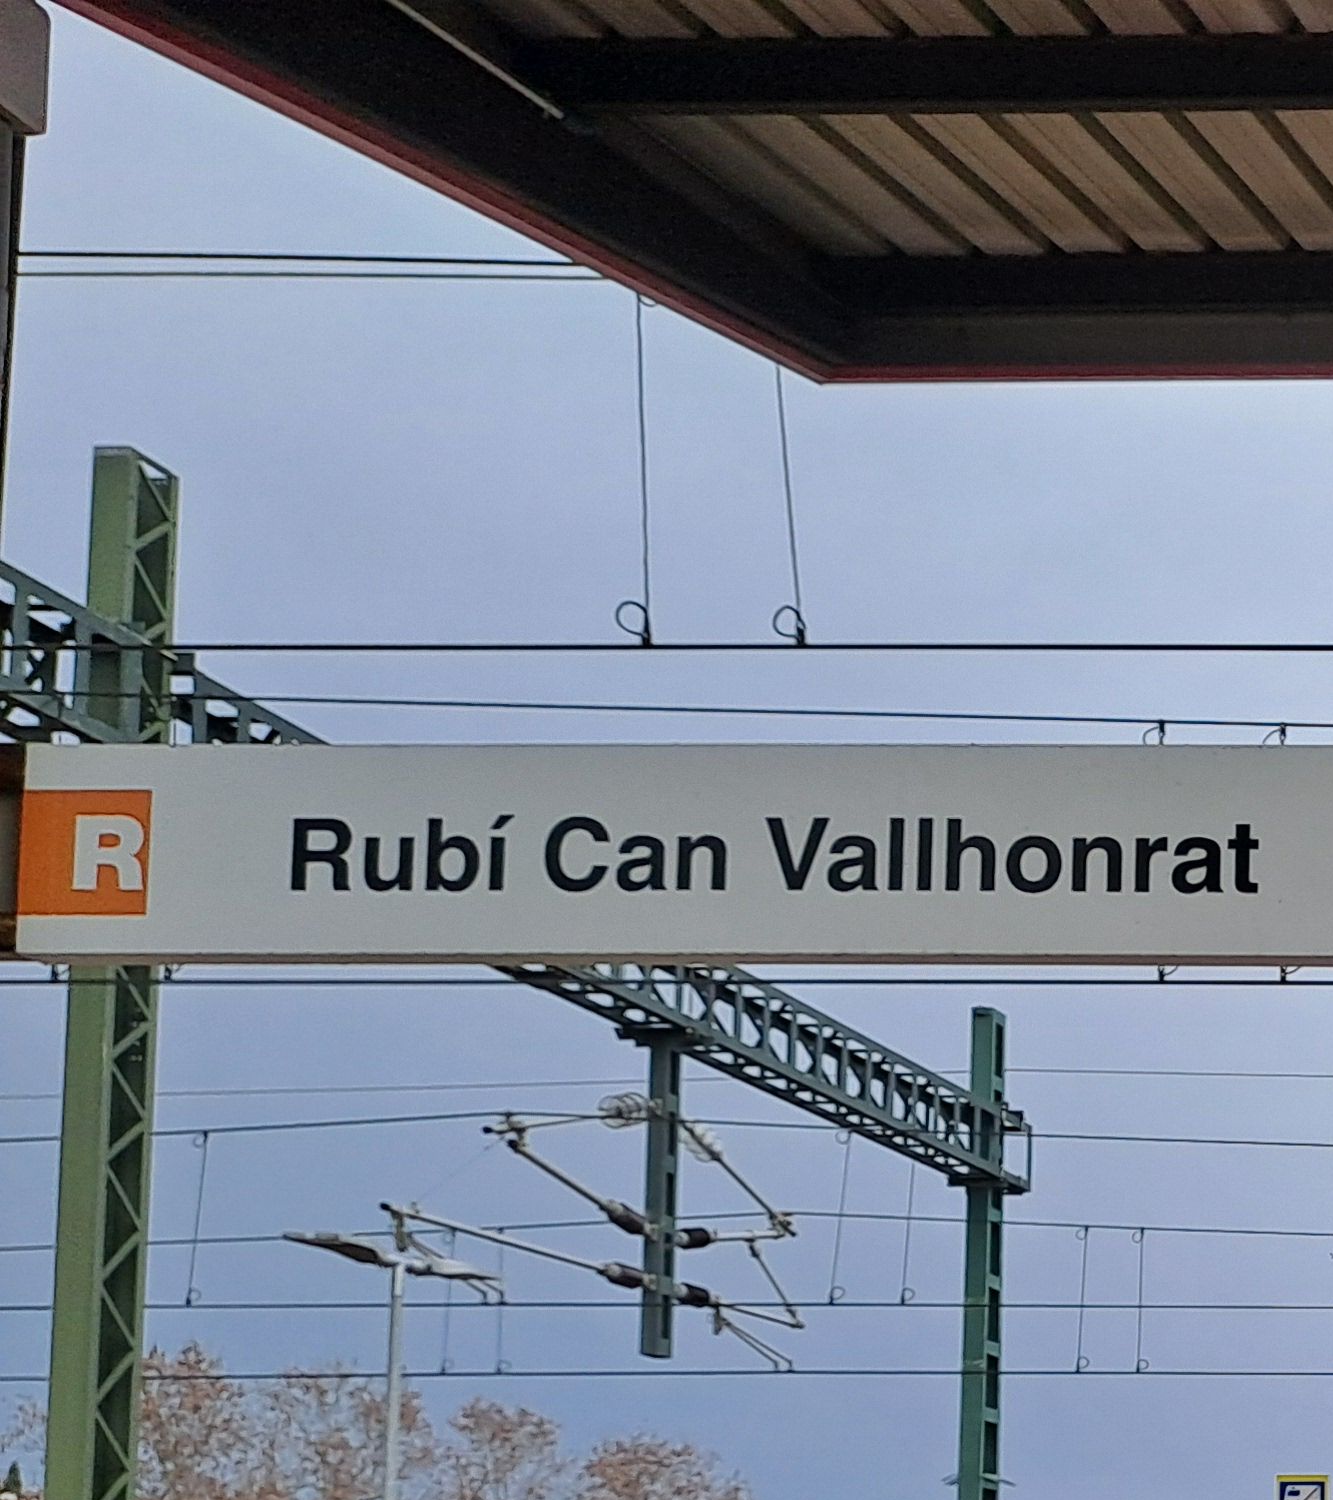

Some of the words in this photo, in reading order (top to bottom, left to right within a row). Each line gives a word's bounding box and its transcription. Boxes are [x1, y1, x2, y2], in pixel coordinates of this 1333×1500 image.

[73, 816, 142, 890] R
[290, 814, 514, 892] Rubí
[544, 816, 727, 893] Can
[765, 817, 1260, 895] Vallhonrat
